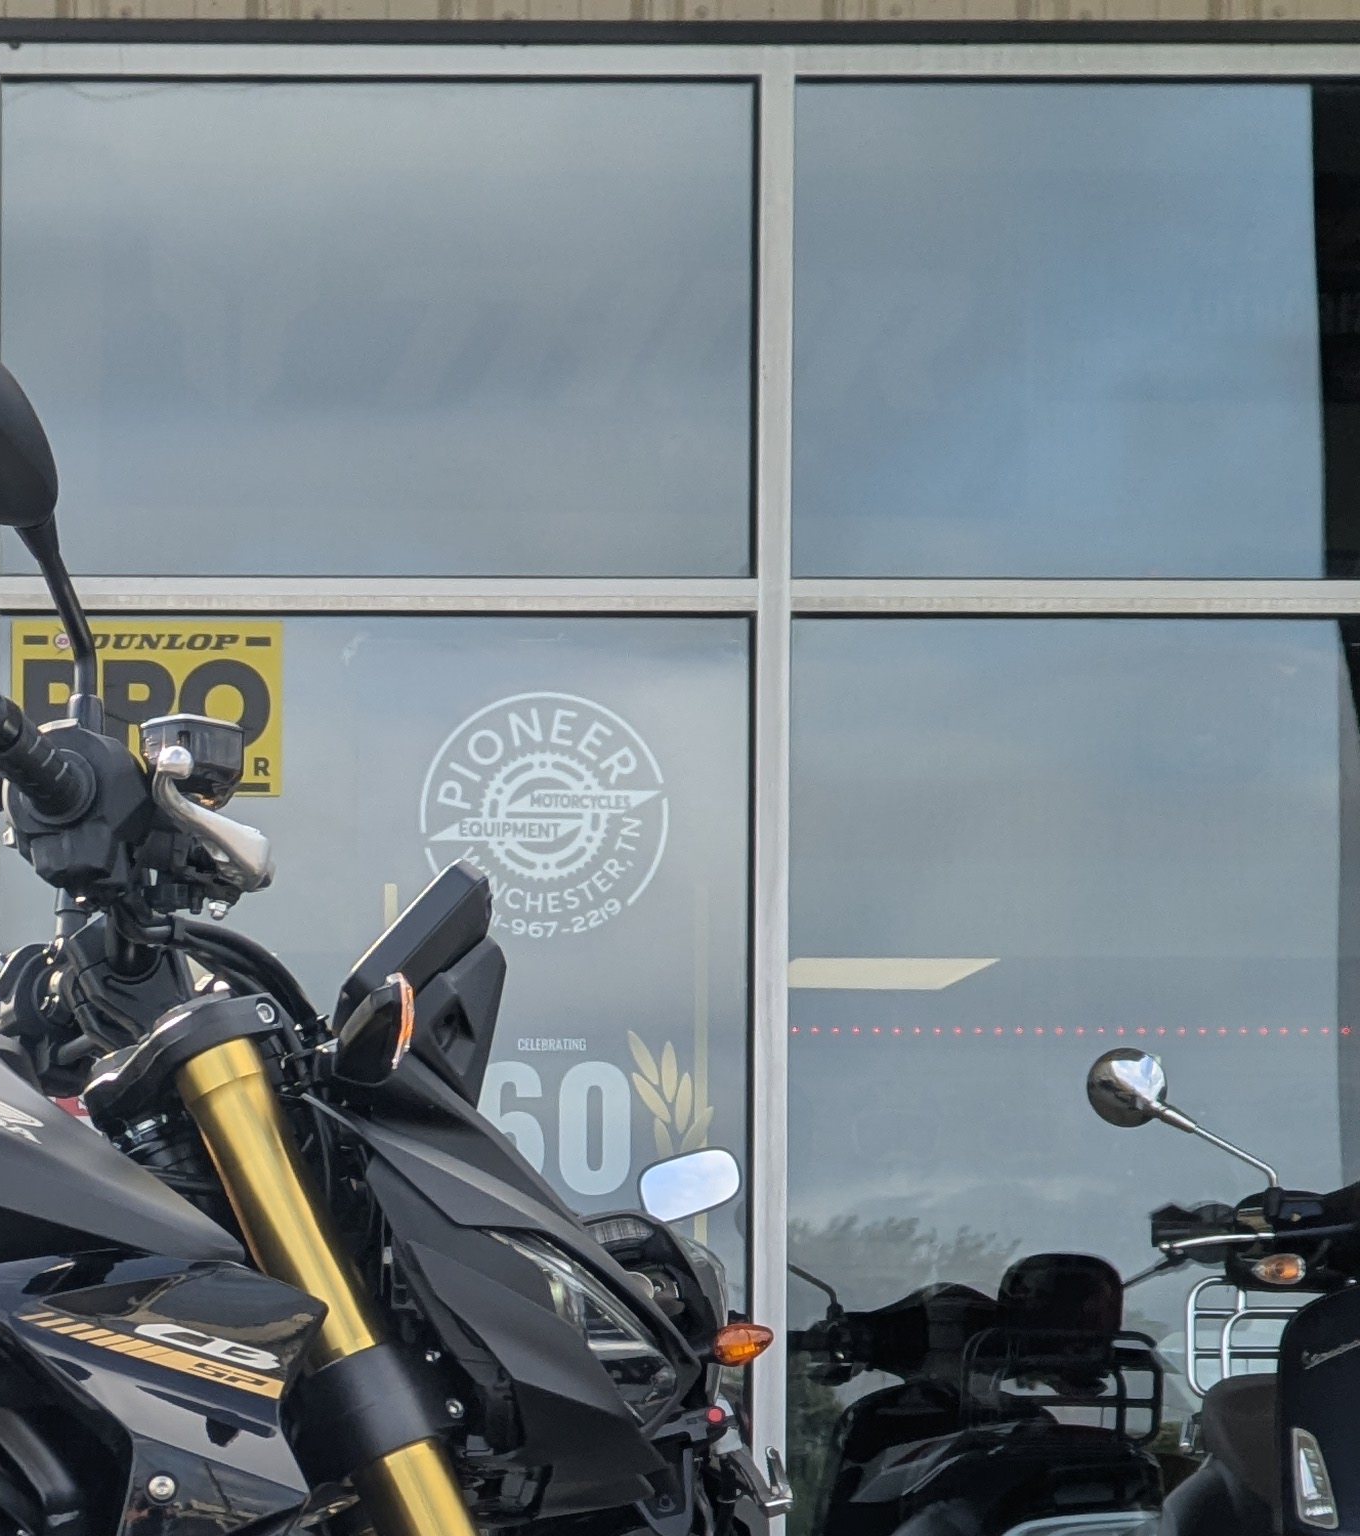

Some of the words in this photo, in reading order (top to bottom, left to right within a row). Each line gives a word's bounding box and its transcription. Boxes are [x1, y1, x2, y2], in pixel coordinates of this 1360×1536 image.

[93, 633, 239, 650] DUNLOP
[437, 708, 637, 811] PIONEER
[529, 793, 629, 811] MOTORCYCLES
[458, 820, 561, 839] EQUIPMENT
[517, 1037, 587, 1052] CELEBRATING
[478, 1060, 631, 1196] 60
[134, 1323, 281, 1370] CB
[187, 1362, 270, 1387] SP
